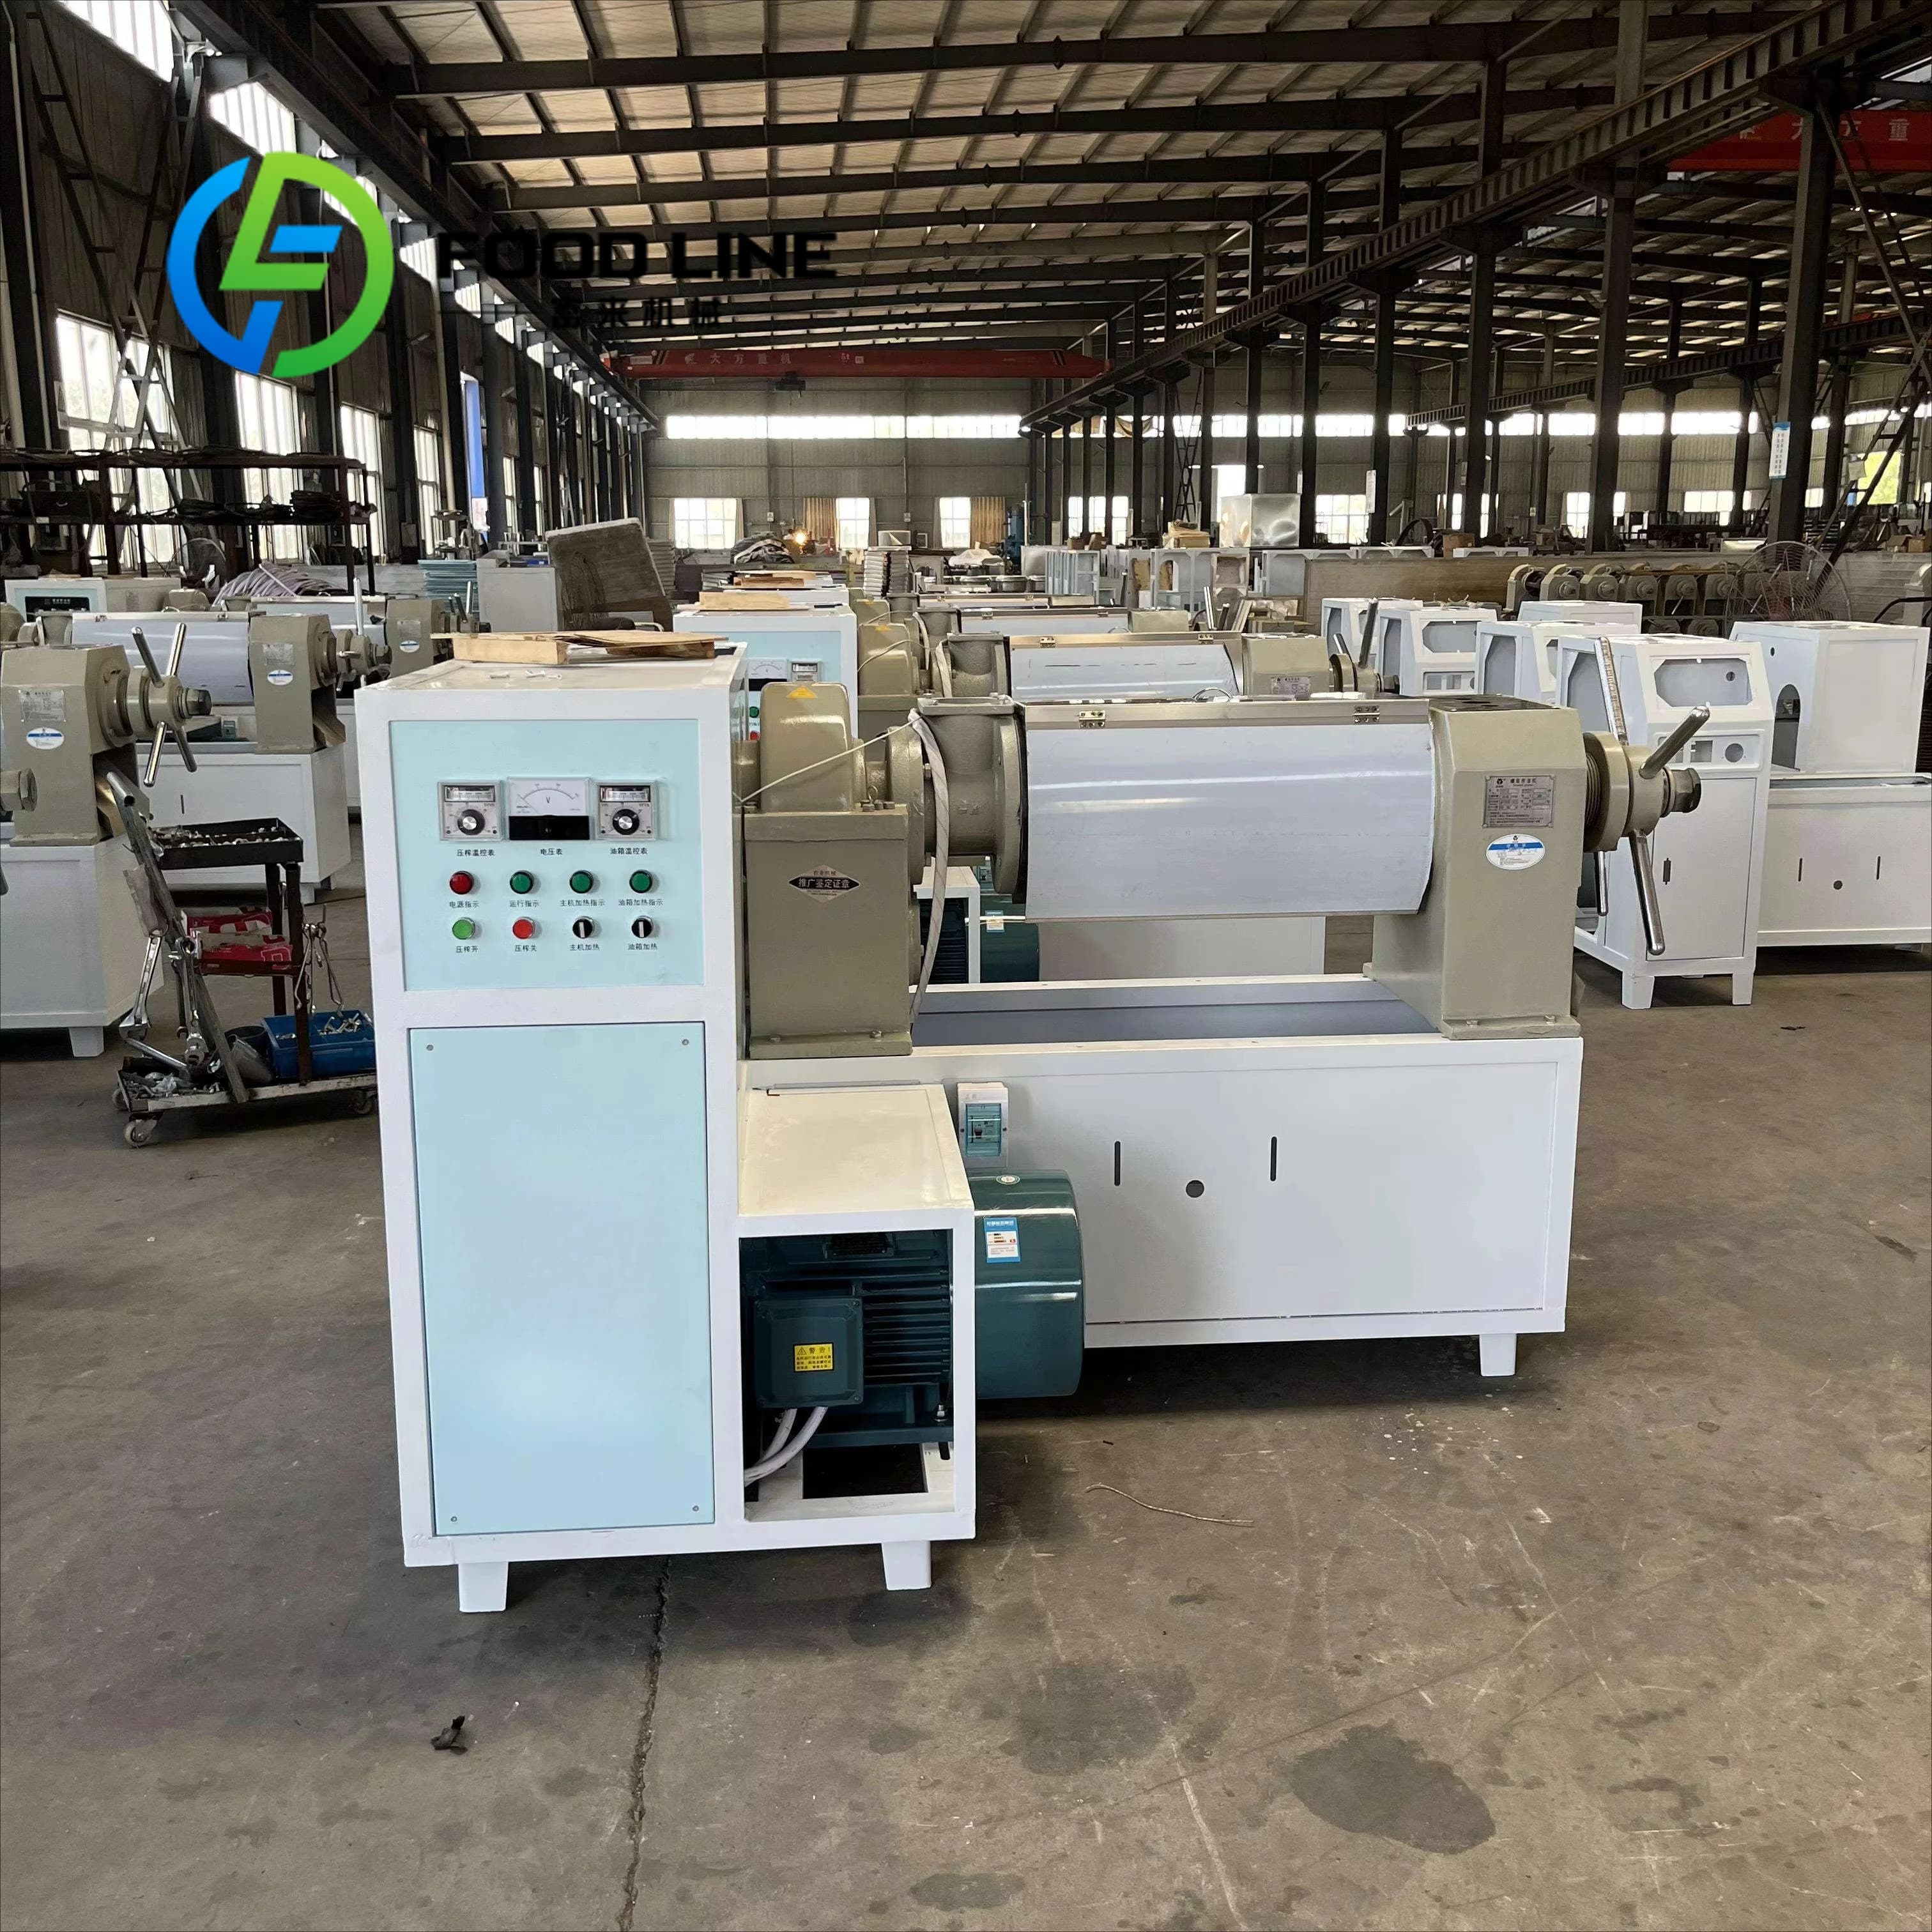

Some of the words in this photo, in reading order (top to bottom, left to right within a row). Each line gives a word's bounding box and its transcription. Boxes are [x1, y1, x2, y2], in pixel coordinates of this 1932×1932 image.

[457, 848, 495, 857] 压榨温控表
[540, 848, 563, 856] 电压表
[610, 847, 648, 855] 油箱温控表
[798, 877, 850, 889] 推广鉴定证章
[449, 900, 480, 908] 电源指示
[509, 900, 540, 908] 运行指示
[560, 899, 606, 907] 主机加热指示
[618, 898, 664, 907] 油箱加热指示
